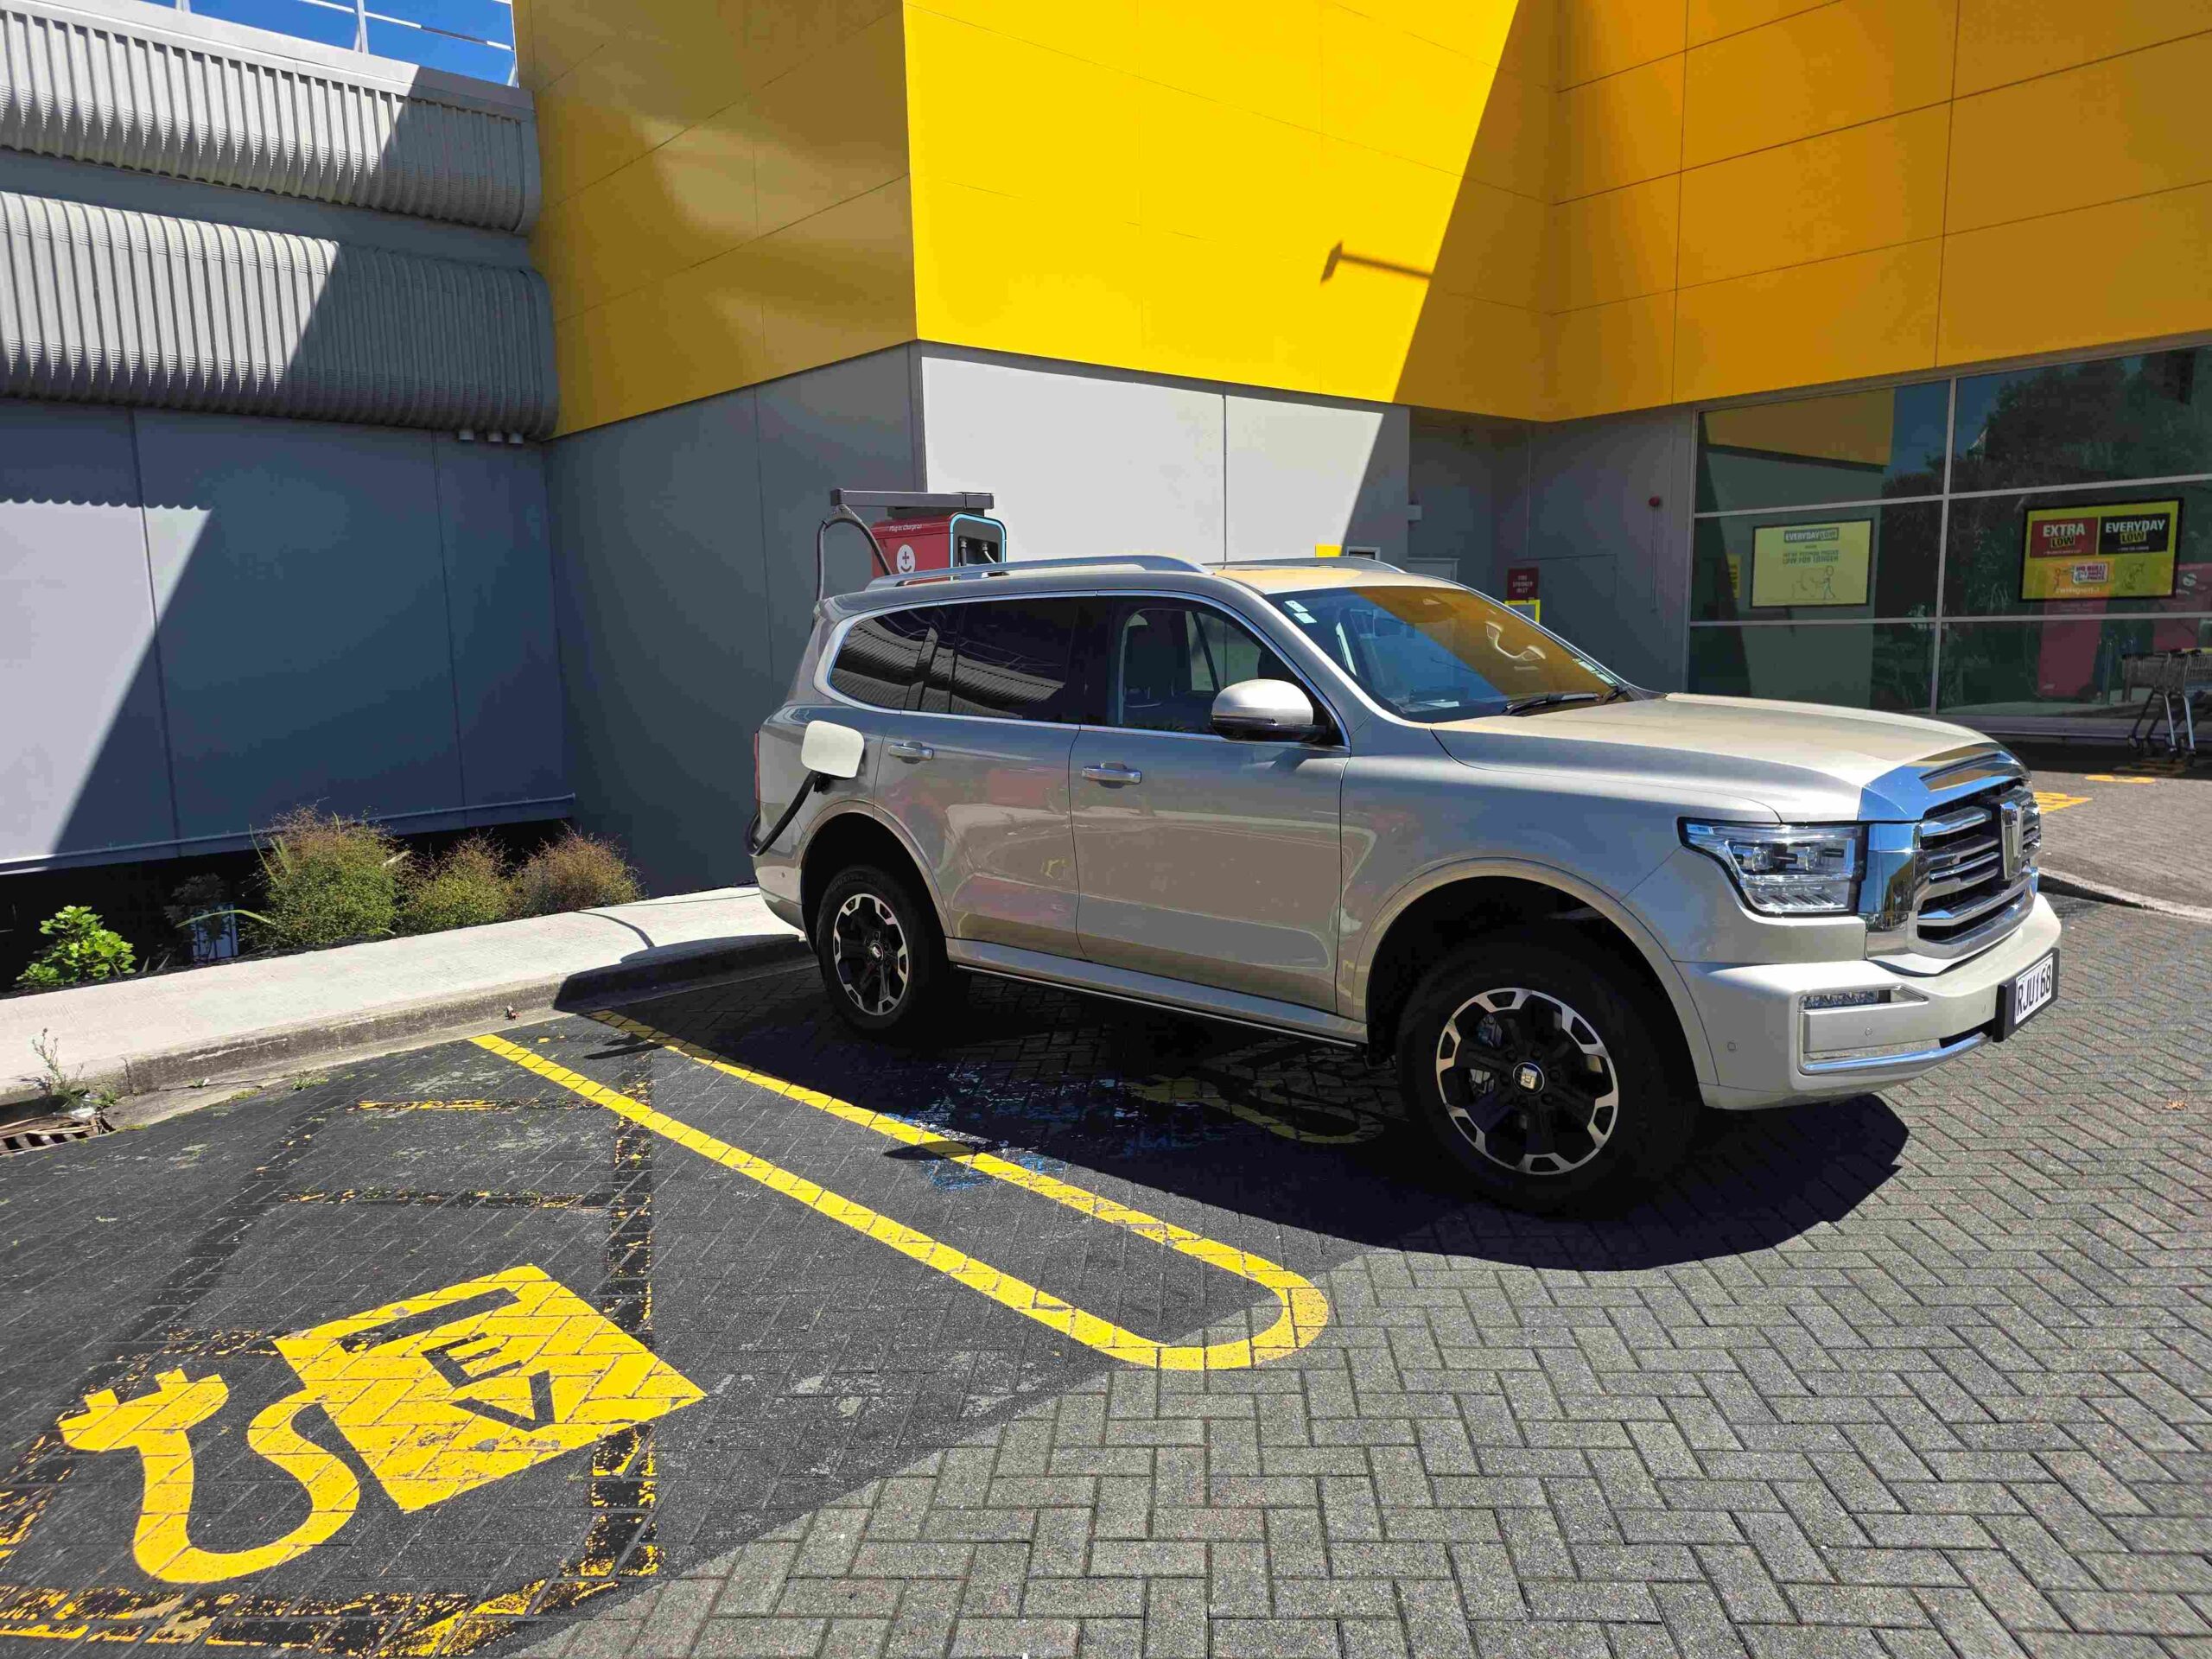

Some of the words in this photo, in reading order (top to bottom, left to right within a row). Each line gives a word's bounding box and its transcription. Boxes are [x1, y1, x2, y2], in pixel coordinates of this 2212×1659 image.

[2043, 523, 2086, 537] EXTRA
[2105, 519, 2165, 533] EVERYDAY
[1785, 531, 1819, 541] EVERYDAY
[2052, 537, 2074, 547] LOW
[2121, 532, 2144, 543] LOW
[2017, 963, 2051, 1017] RJU168
[421, 1332, 556, 1433] EV
